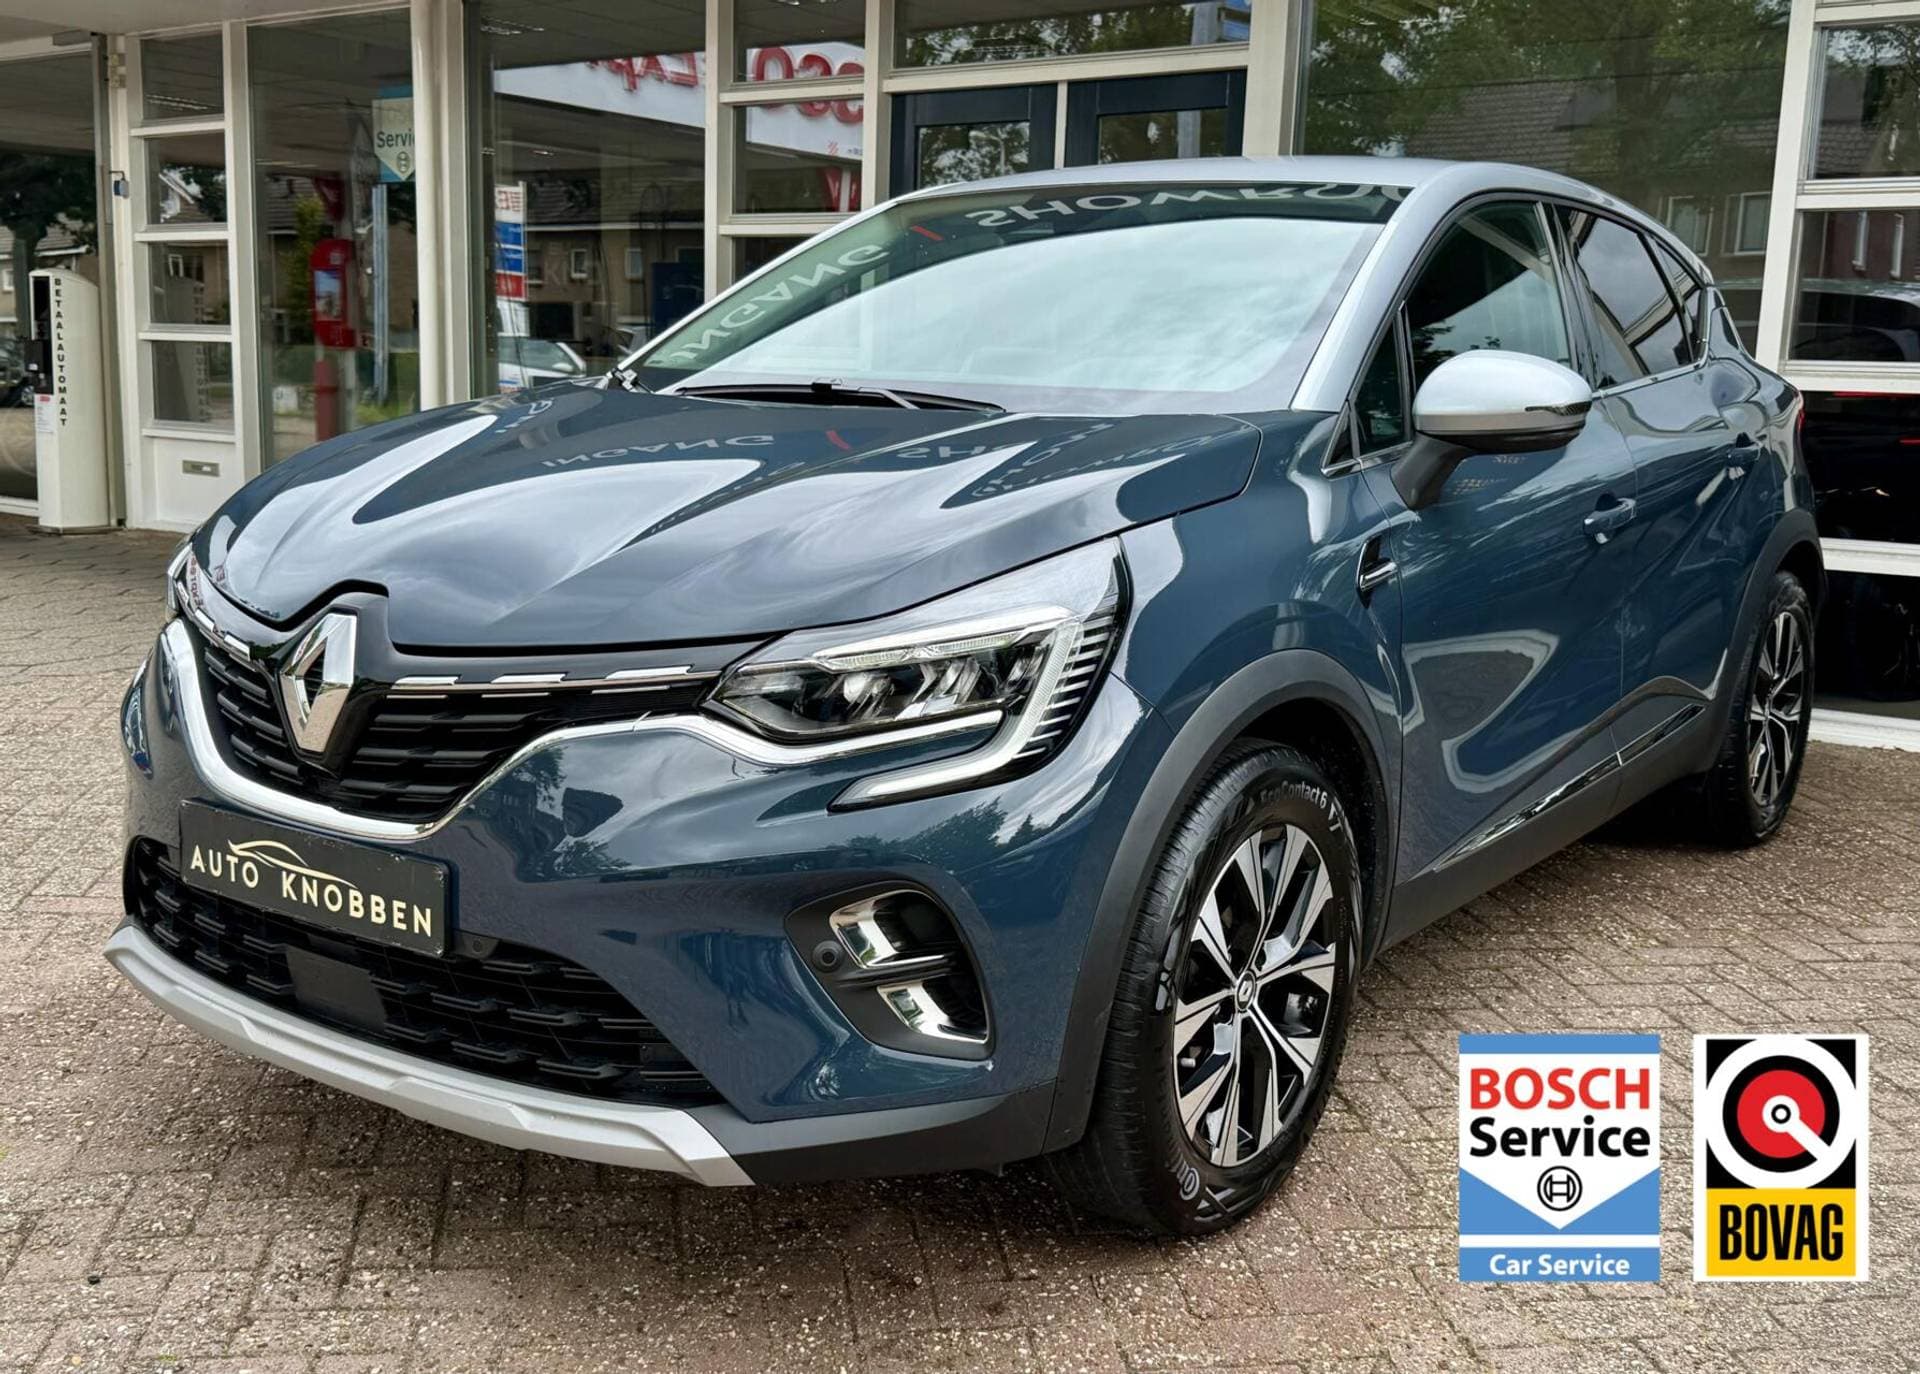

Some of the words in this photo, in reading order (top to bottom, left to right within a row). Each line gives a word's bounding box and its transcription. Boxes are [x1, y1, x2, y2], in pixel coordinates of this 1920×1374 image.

[376, 128, 415, 148] Servi
[54, 277, 67, 427] BETAALAUTOMAAT
[190, 845, 259, 888] AUTO
[281, 870, 432, 938] KNOBBEN
